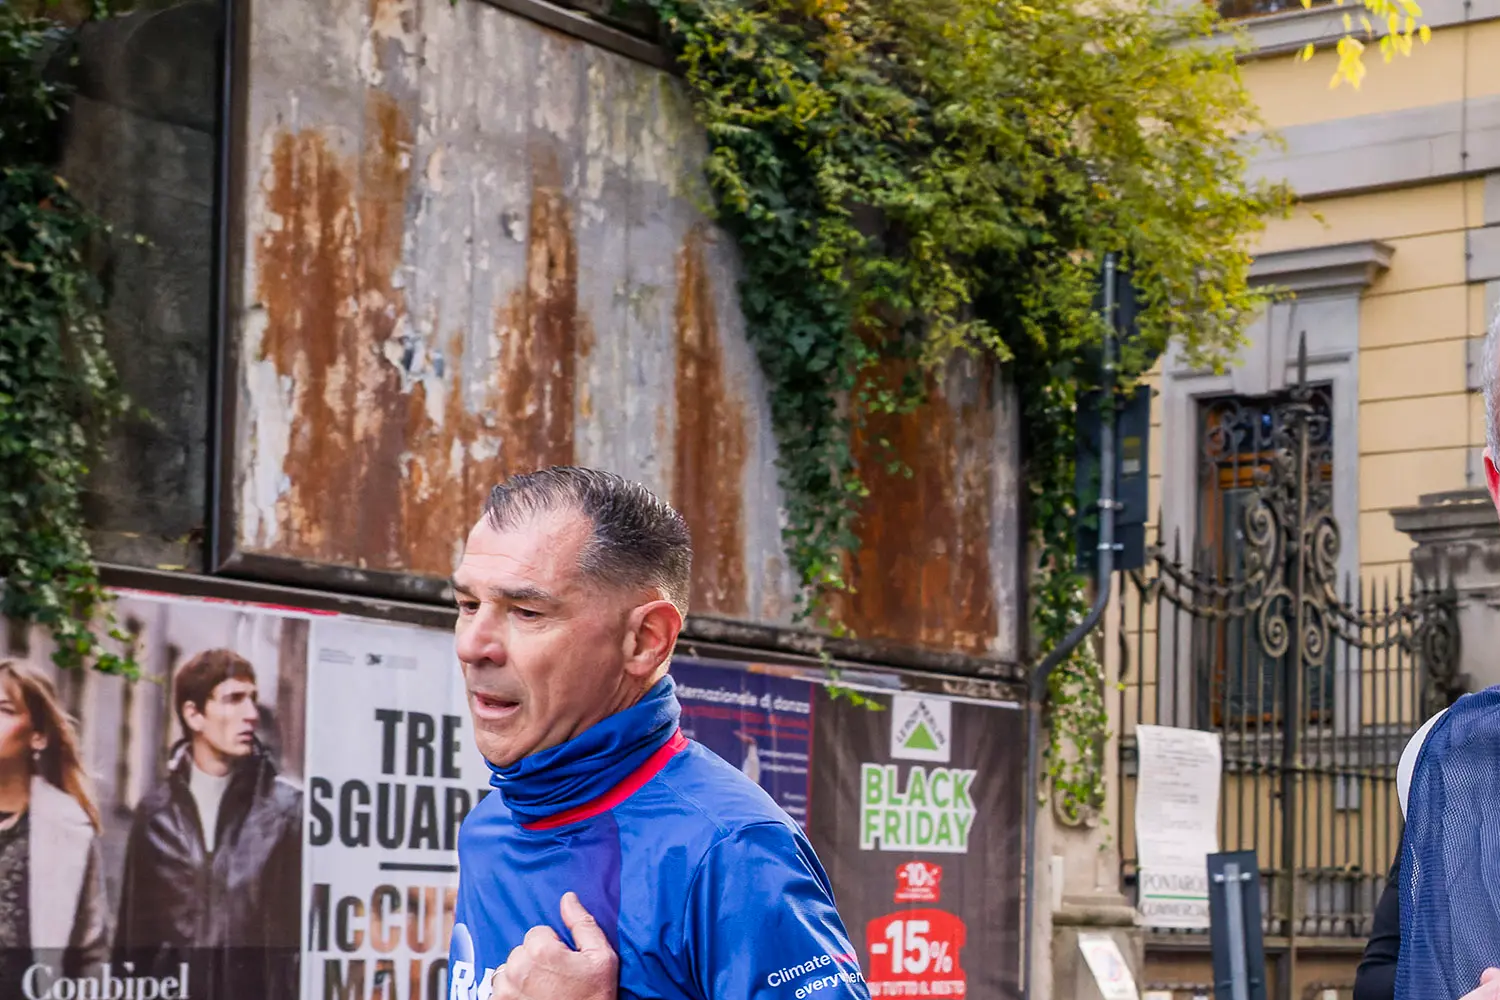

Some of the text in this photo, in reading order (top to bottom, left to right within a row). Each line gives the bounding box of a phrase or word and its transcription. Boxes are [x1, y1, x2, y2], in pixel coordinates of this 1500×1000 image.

[375, 708, 462, 779] TRE
[864, 765, 972, 808] BLACK
[864, 808, 971, 846] FRIDAY
[871, 919, 952, 975] -15%
[767, 954, 832, 988] Climate
